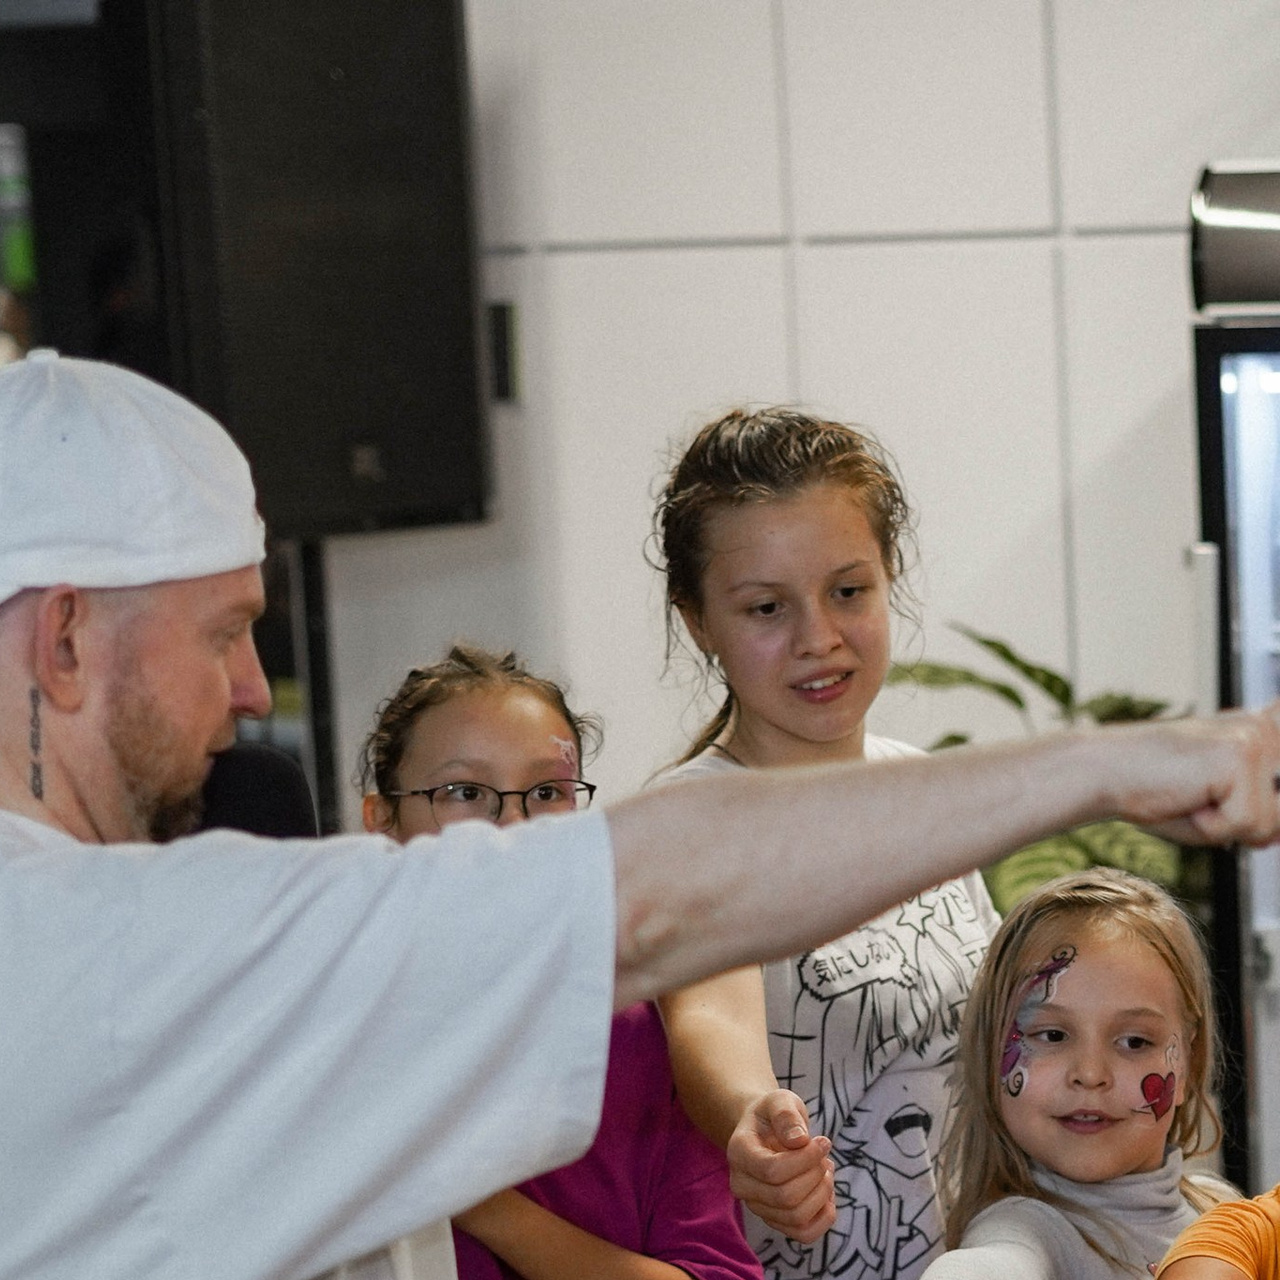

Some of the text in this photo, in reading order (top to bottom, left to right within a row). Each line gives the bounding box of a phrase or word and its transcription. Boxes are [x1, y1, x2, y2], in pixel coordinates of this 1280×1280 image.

[812, 939, 897, 987] 気にしない
